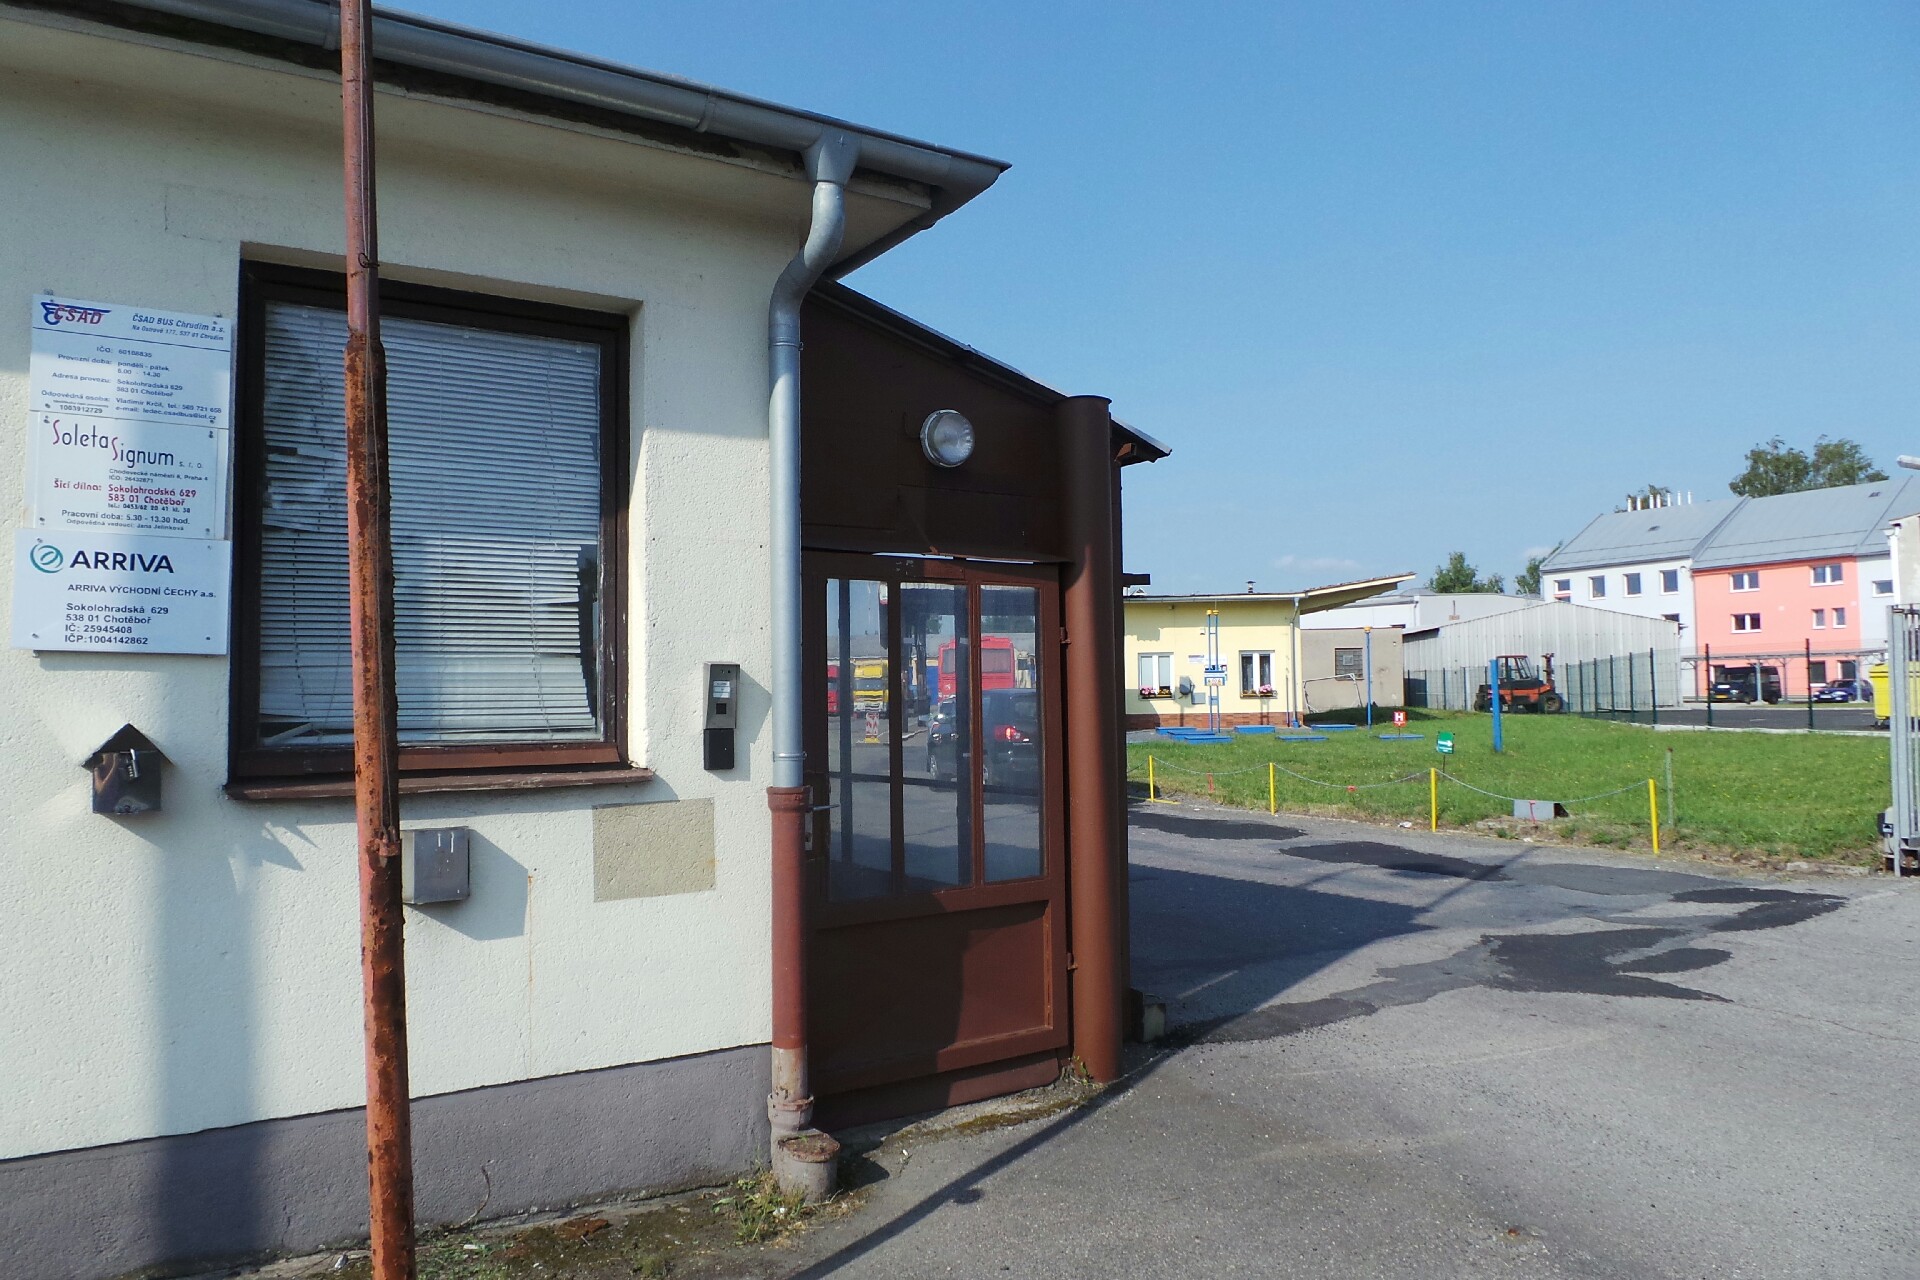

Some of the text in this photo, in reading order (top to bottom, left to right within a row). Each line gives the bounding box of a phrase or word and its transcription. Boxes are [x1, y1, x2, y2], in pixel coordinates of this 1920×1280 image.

[132, 313, 155, 324] ČSAD
[156, 317, 174, 326] BUS
[176, 320, 209, 331] Chrudim
[199, 333, 224, 341] Chrudim
[97, 346, 113, 354] IČO:
[58, 354, 90, 362] Provozní
[52, 372, 78, 380] Adresa
[112, 436, 174, 469] Signum
[74, 481, 102, 491] dílna:
[108, 484, 175, 496] Sokolohradská
[179, 488, 197, 498] 629
[108, 493, 186, 506] 583 01 Chotěboř
[61, 509, 99, 520] Pracovní
[100, 511, 123, 521] doba:
[126, 514, 143, 522] 5.30
[150, 515, 171, 524] 13.30
[172, 517, 191, 525] hod.
[66, 518, 106, 528] Odpovědná
[69, 549, 175, 574] ARRIVA
[67, 583, 107, 593] ARRIVA
[109, 584, 161, 596] VÝCHODNÍ
[163, 586, 198, 598] ČECHY
[66, 602, 169, 614] Sokolohradská 629
[66, 614, 152, 624] 538 01 Chotěboř
[64, 622, 132, 634] IČ: 25945408
[1394, 711, 1404, 721] H
